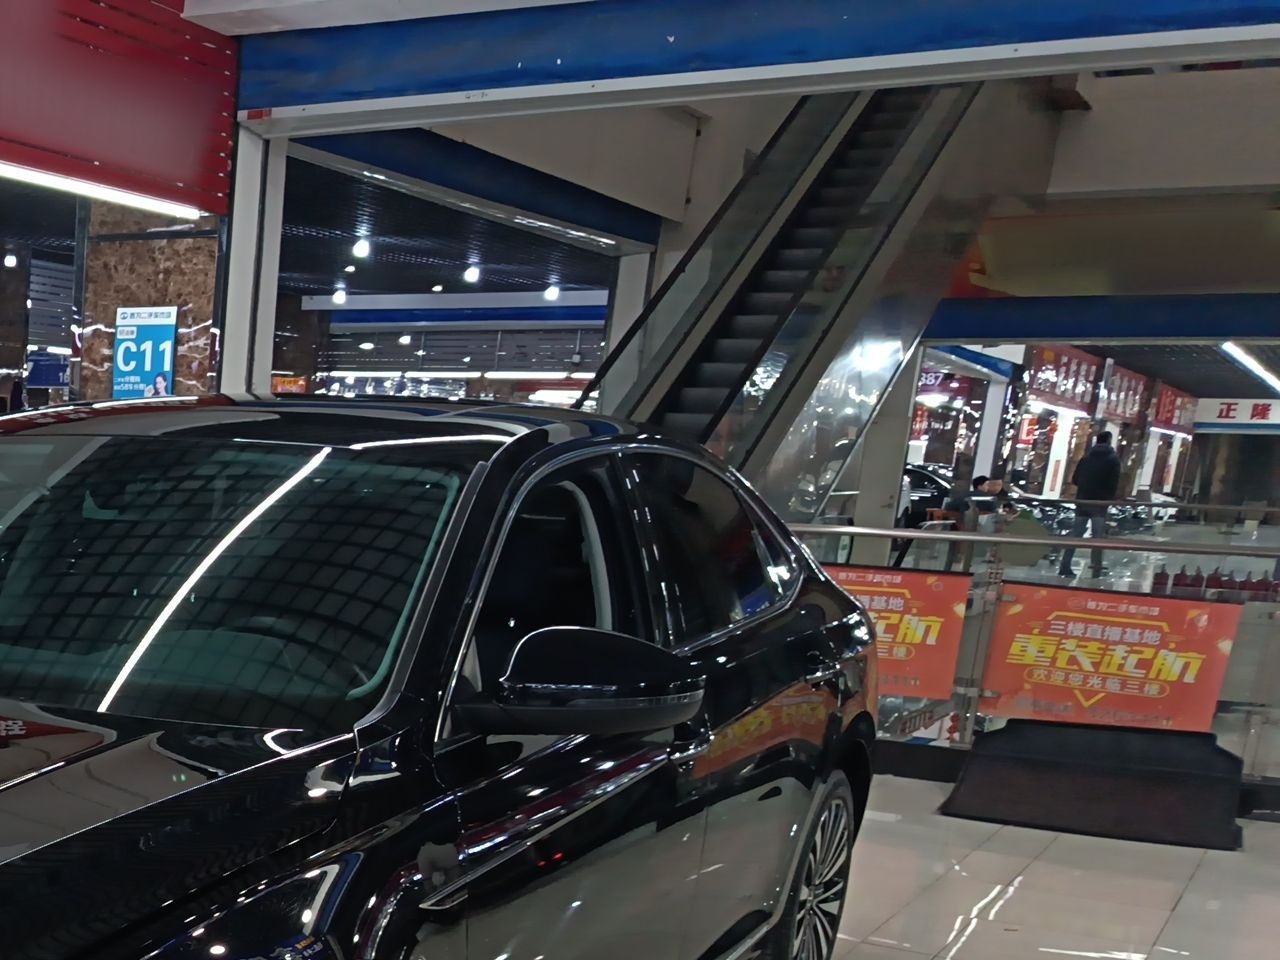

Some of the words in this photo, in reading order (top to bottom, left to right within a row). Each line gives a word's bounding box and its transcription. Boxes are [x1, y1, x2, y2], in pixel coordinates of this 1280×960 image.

[117, 340, 172, 372] C11
[1048, 619, 1161, 645] 三楼直播基地
[1006, 633, 1207, 684] 重装起航
[1032, 668, 1161, 696] 欢迎您光临三楼
